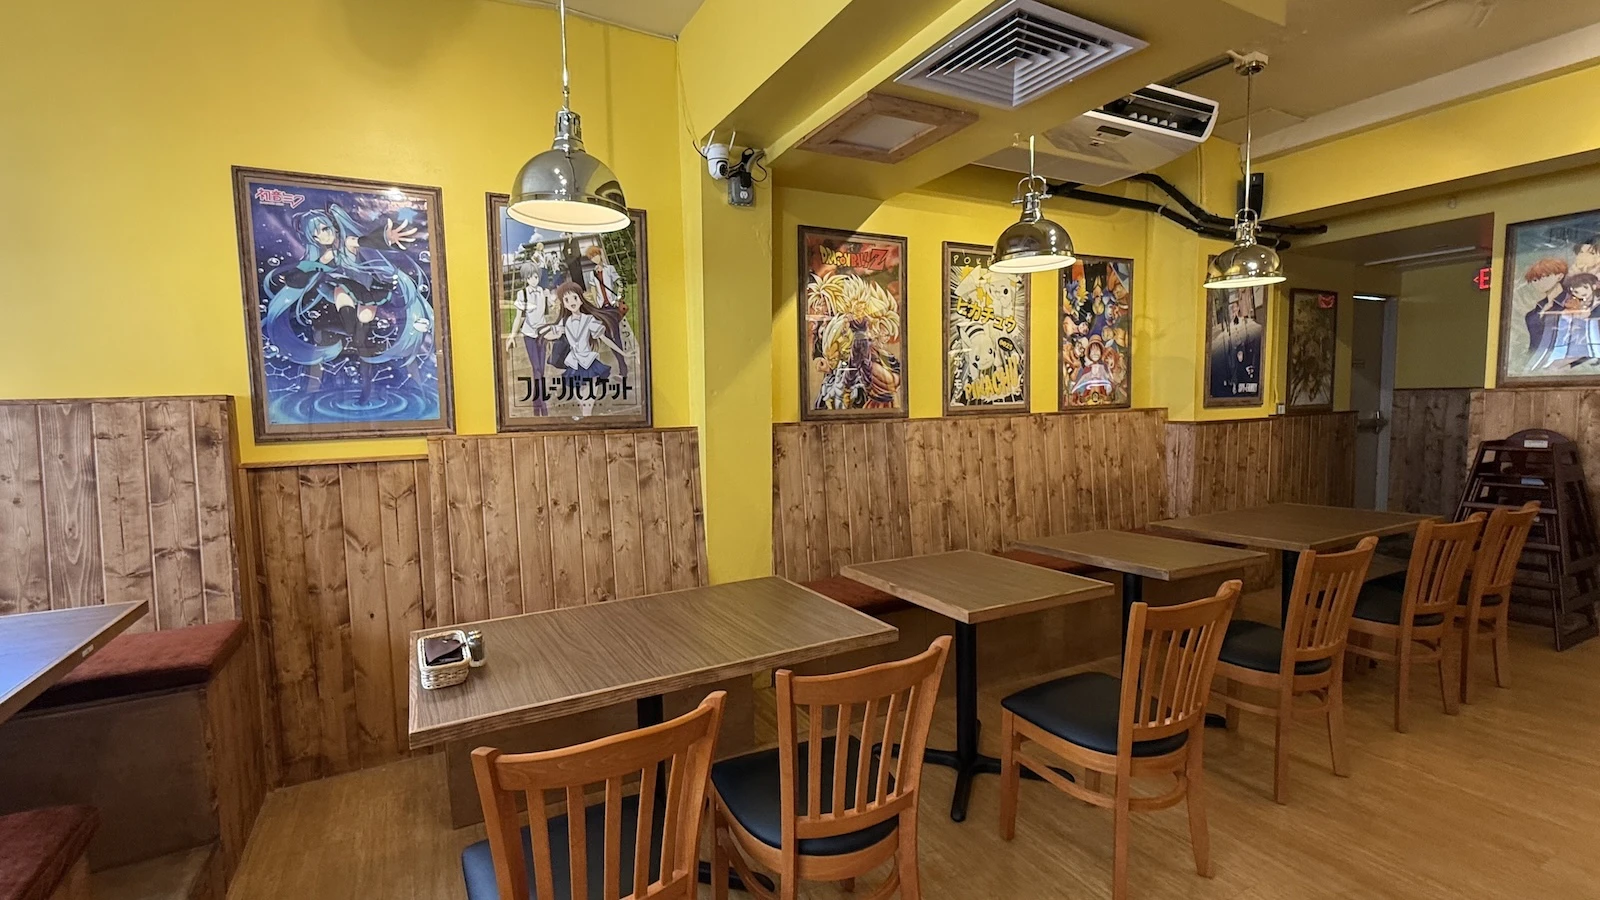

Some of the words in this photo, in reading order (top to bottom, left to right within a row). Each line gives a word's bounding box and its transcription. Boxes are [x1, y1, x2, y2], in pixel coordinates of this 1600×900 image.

[518, 375, 633, 402] フルーツバスケット
